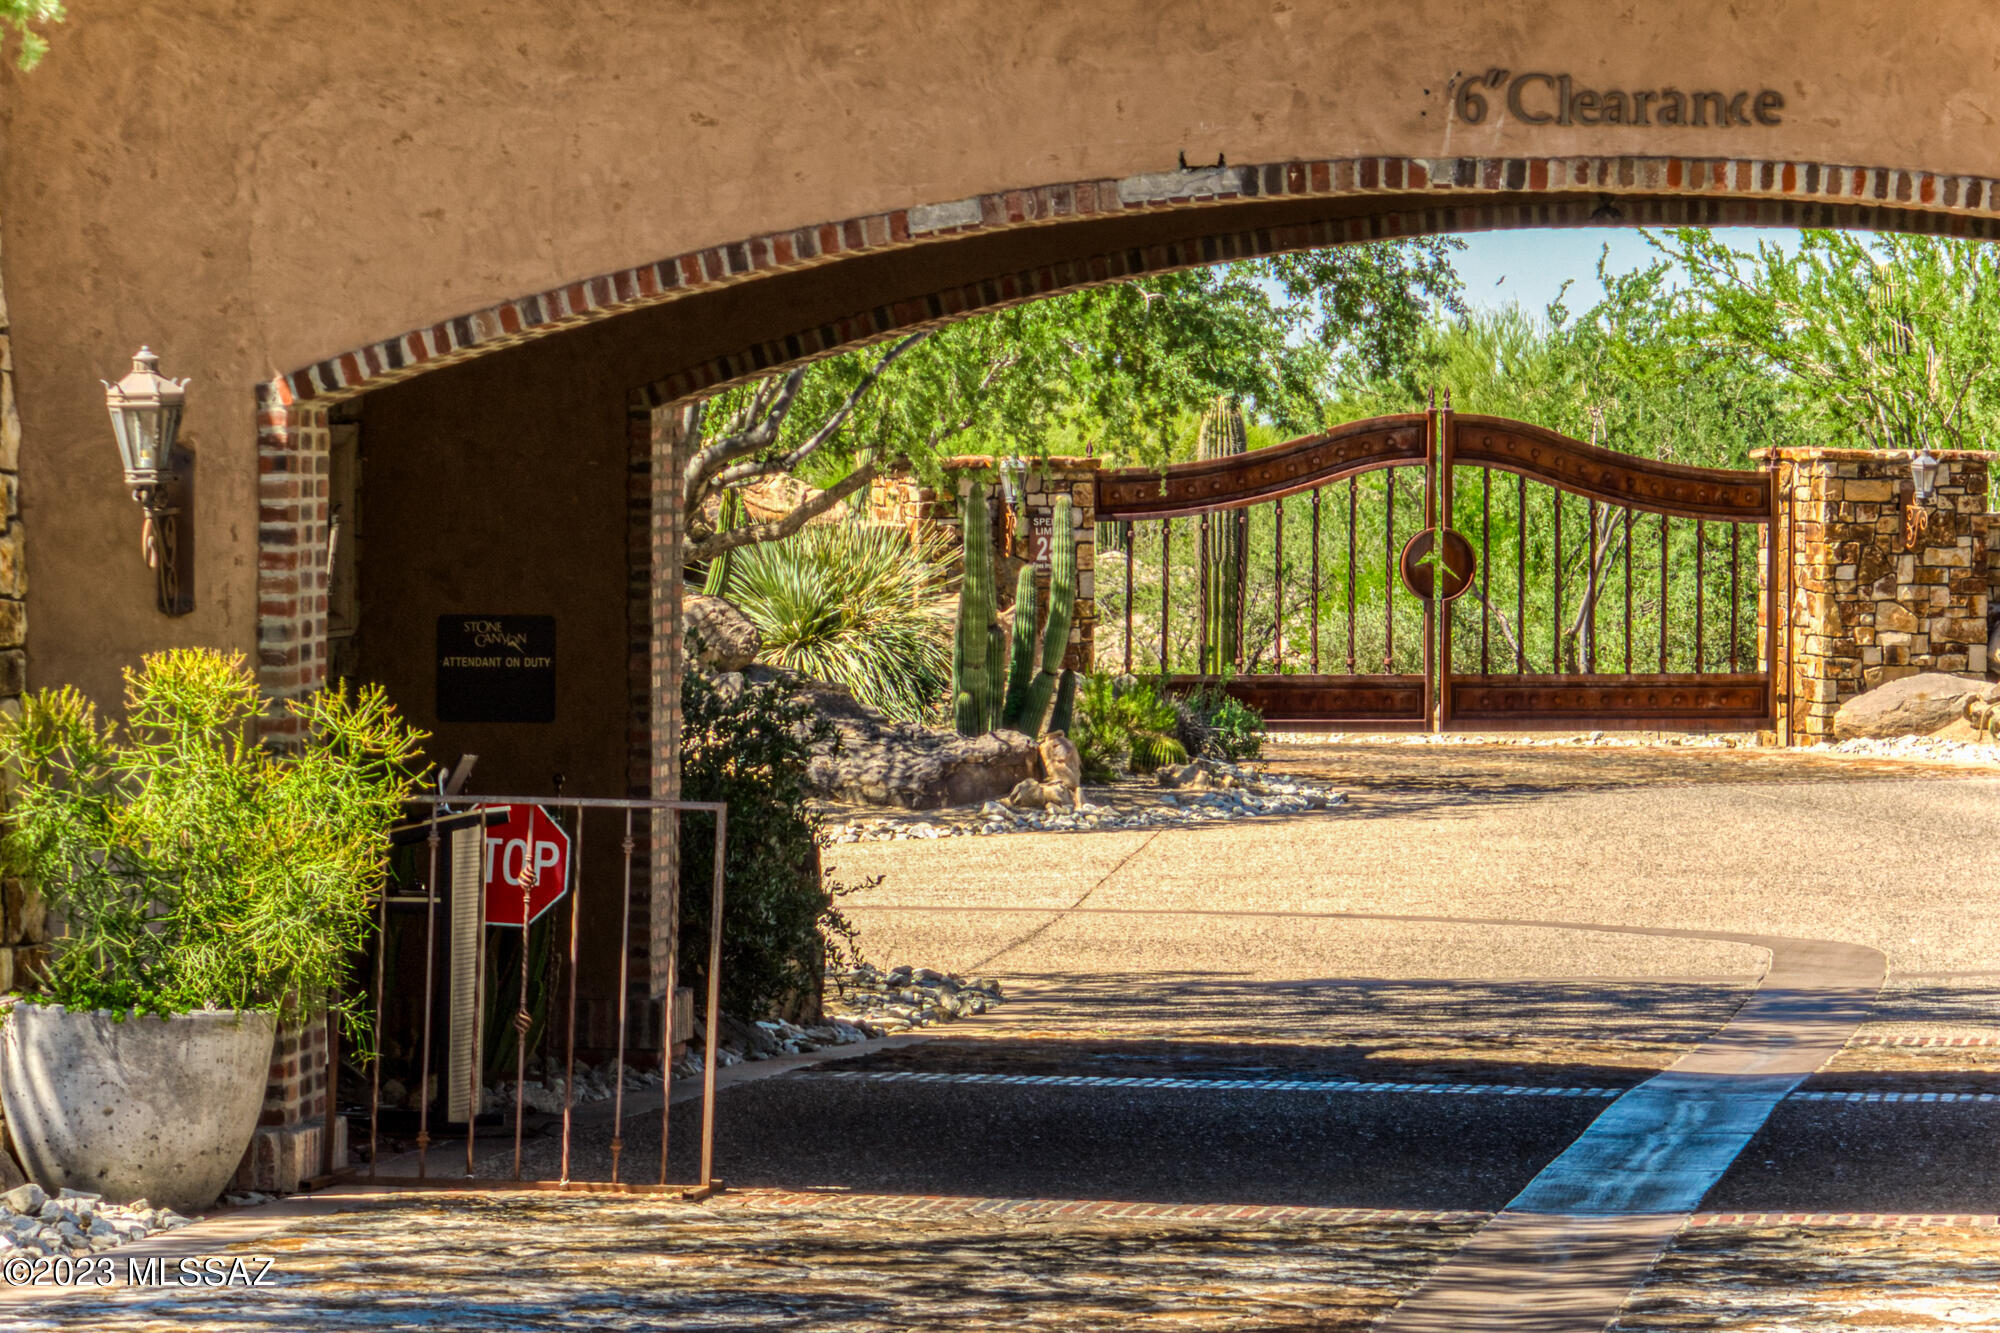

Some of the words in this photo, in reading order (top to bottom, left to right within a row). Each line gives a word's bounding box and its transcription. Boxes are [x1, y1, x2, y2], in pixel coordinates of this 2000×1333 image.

[1506, 72, 1785, 127] Clearance
[463, 621, 502, 633] STONE
[474, 633, 527, 650] CANYON
[442, 656, 502, 668] ATTENDANT
[505, 656, 520, 668] ON
[523, 656, 551, 668] DUTY
[485, 837, 560, 887] TOP
